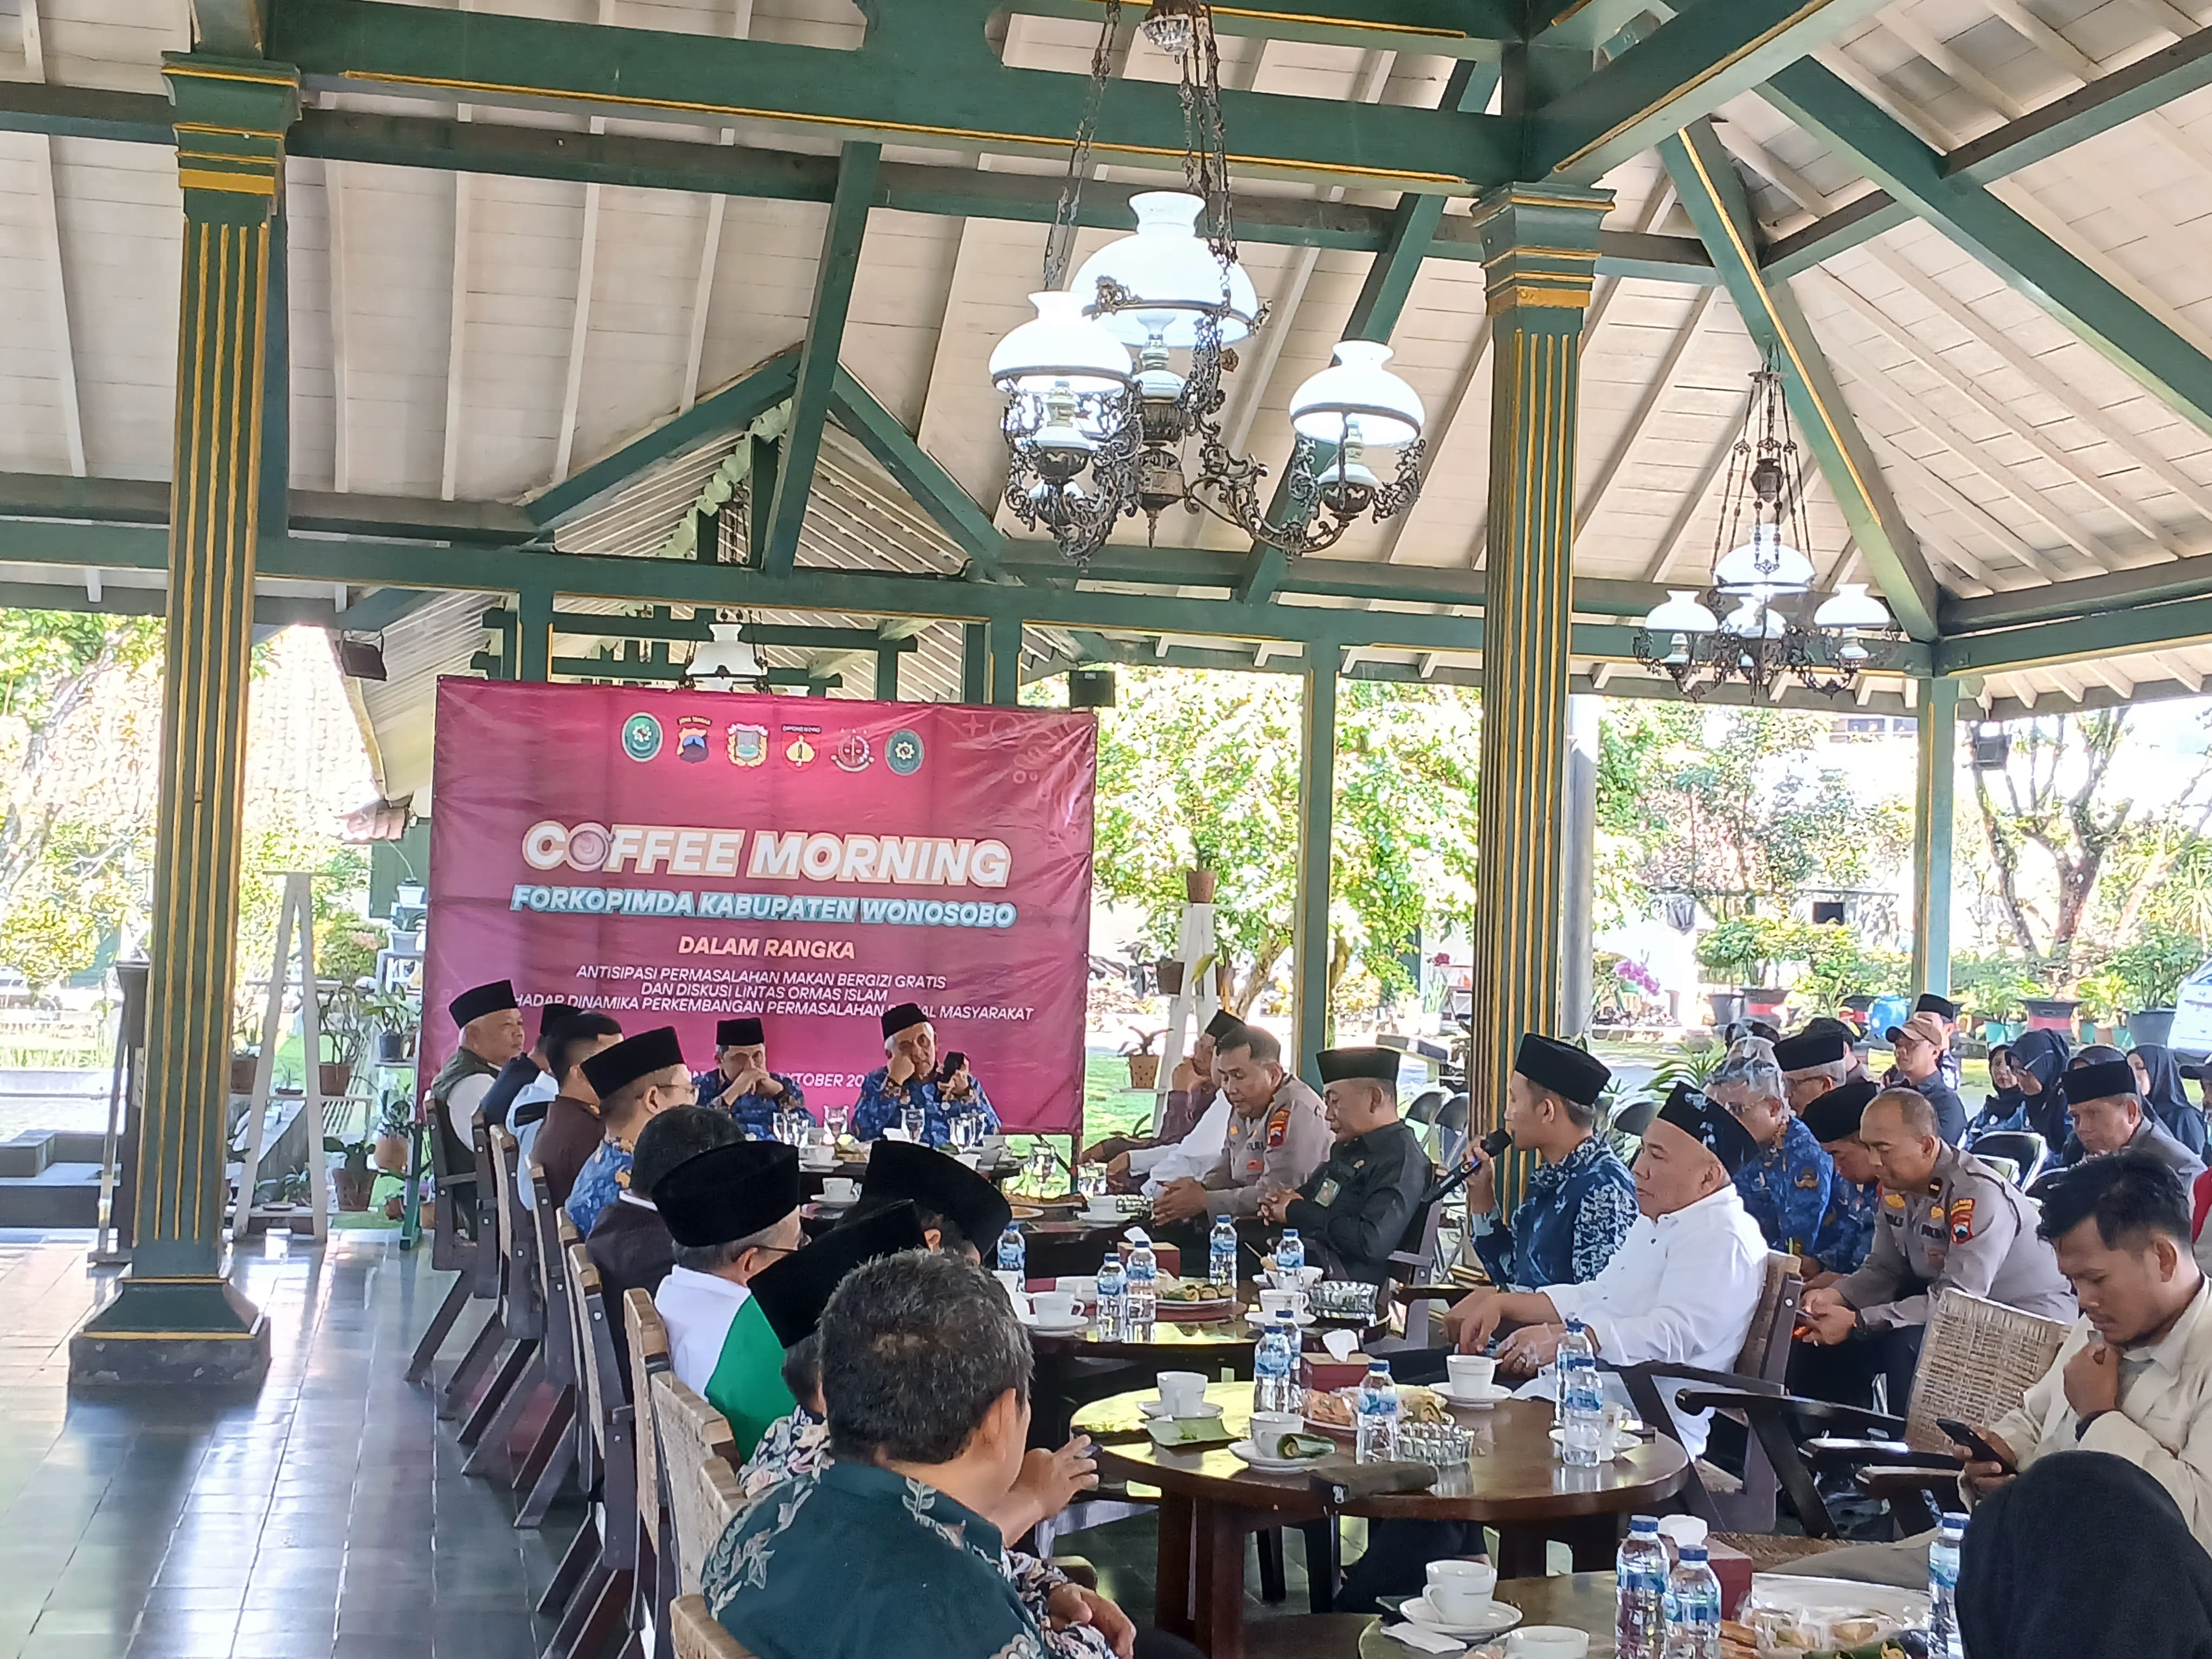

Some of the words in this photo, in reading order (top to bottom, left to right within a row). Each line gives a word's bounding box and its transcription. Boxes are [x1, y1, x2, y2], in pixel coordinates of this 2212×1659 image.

[523, 821, 745, 876] COFFEE
[748, 831, 1011, 887] MORNING
[510, 885, 695, 916] FORKOPIMDA
[697, 892, 858, 922] KABUPATEN
[860, 898, 1017, 928] WONOSOBO
[678, 936, 758, 956] DALAM
[763, 939, 855, 959] RANGKA
[576, 964, 658, 980] ANTISIPASI
[660, 967, 781, 983] PERMASALAHAN
[782, 972, 835, 986] MAKAN
[838, 974, 893, 987] BERGIZI
[895, 975, 947, 989] GRATIS
[641, 982, 671, 995] DAN
[673, 983, 732, 998] DISKUSI
[735, 985, 786, 999] LINTAS
[788, 987, 841, 1001] ORMAS
[843, 989, 888, 1002] ISLAM
[515, 993, 564, 1007] HADAP
[568, 995, 639, 1009] DINAMIKA
[642, 998, 763, 1013] PERKEMBANGAN
[767, 1001, 884, 1017] PERMASALAHAN
[940, 1006, 1035, 1020] MASYARAKAT
[783, 1072, 843, 1088] KTOBER
[847, 1074, 865, 1088] 20
